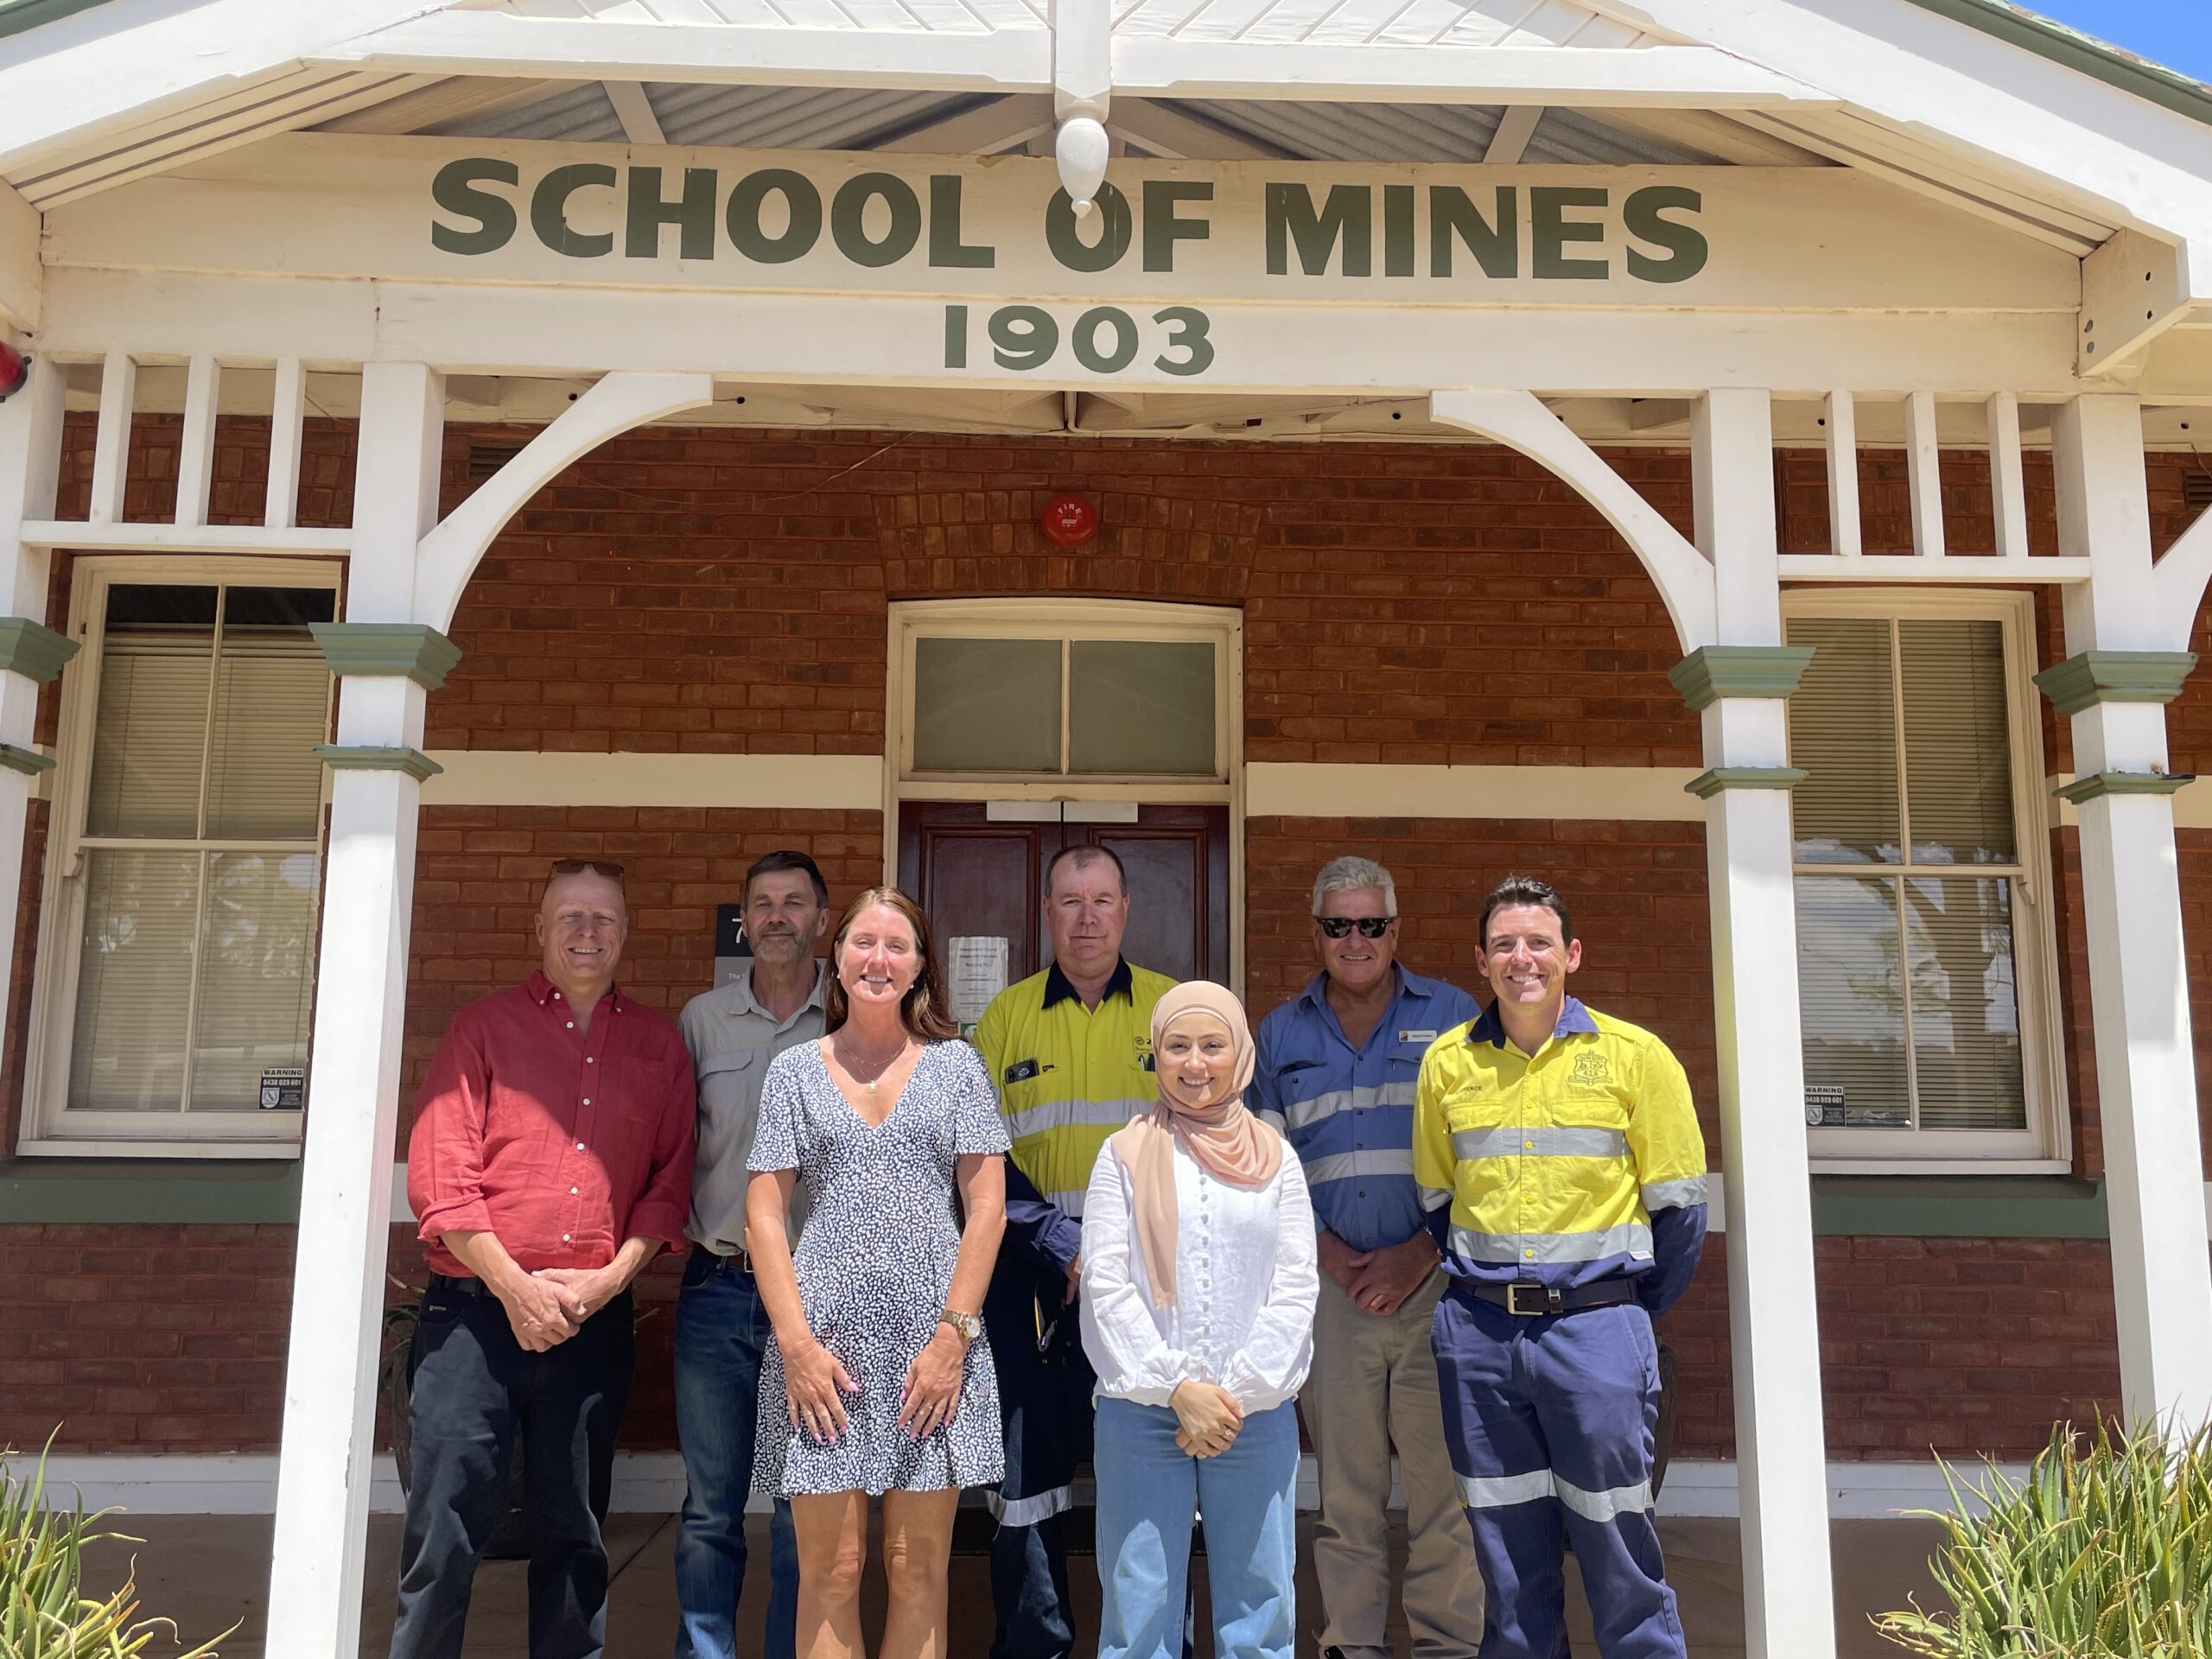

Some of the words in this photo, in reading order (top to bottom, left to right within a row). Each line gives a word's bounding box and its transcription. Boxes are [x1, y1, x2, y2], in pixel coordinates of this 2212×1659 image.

[431, 157, 995, 269] SCHOOL
[1045, 180, 1215, 273] OF
[1265, 181, 1709, 283] MINES
[944, 304, 1215, 377] 1903
